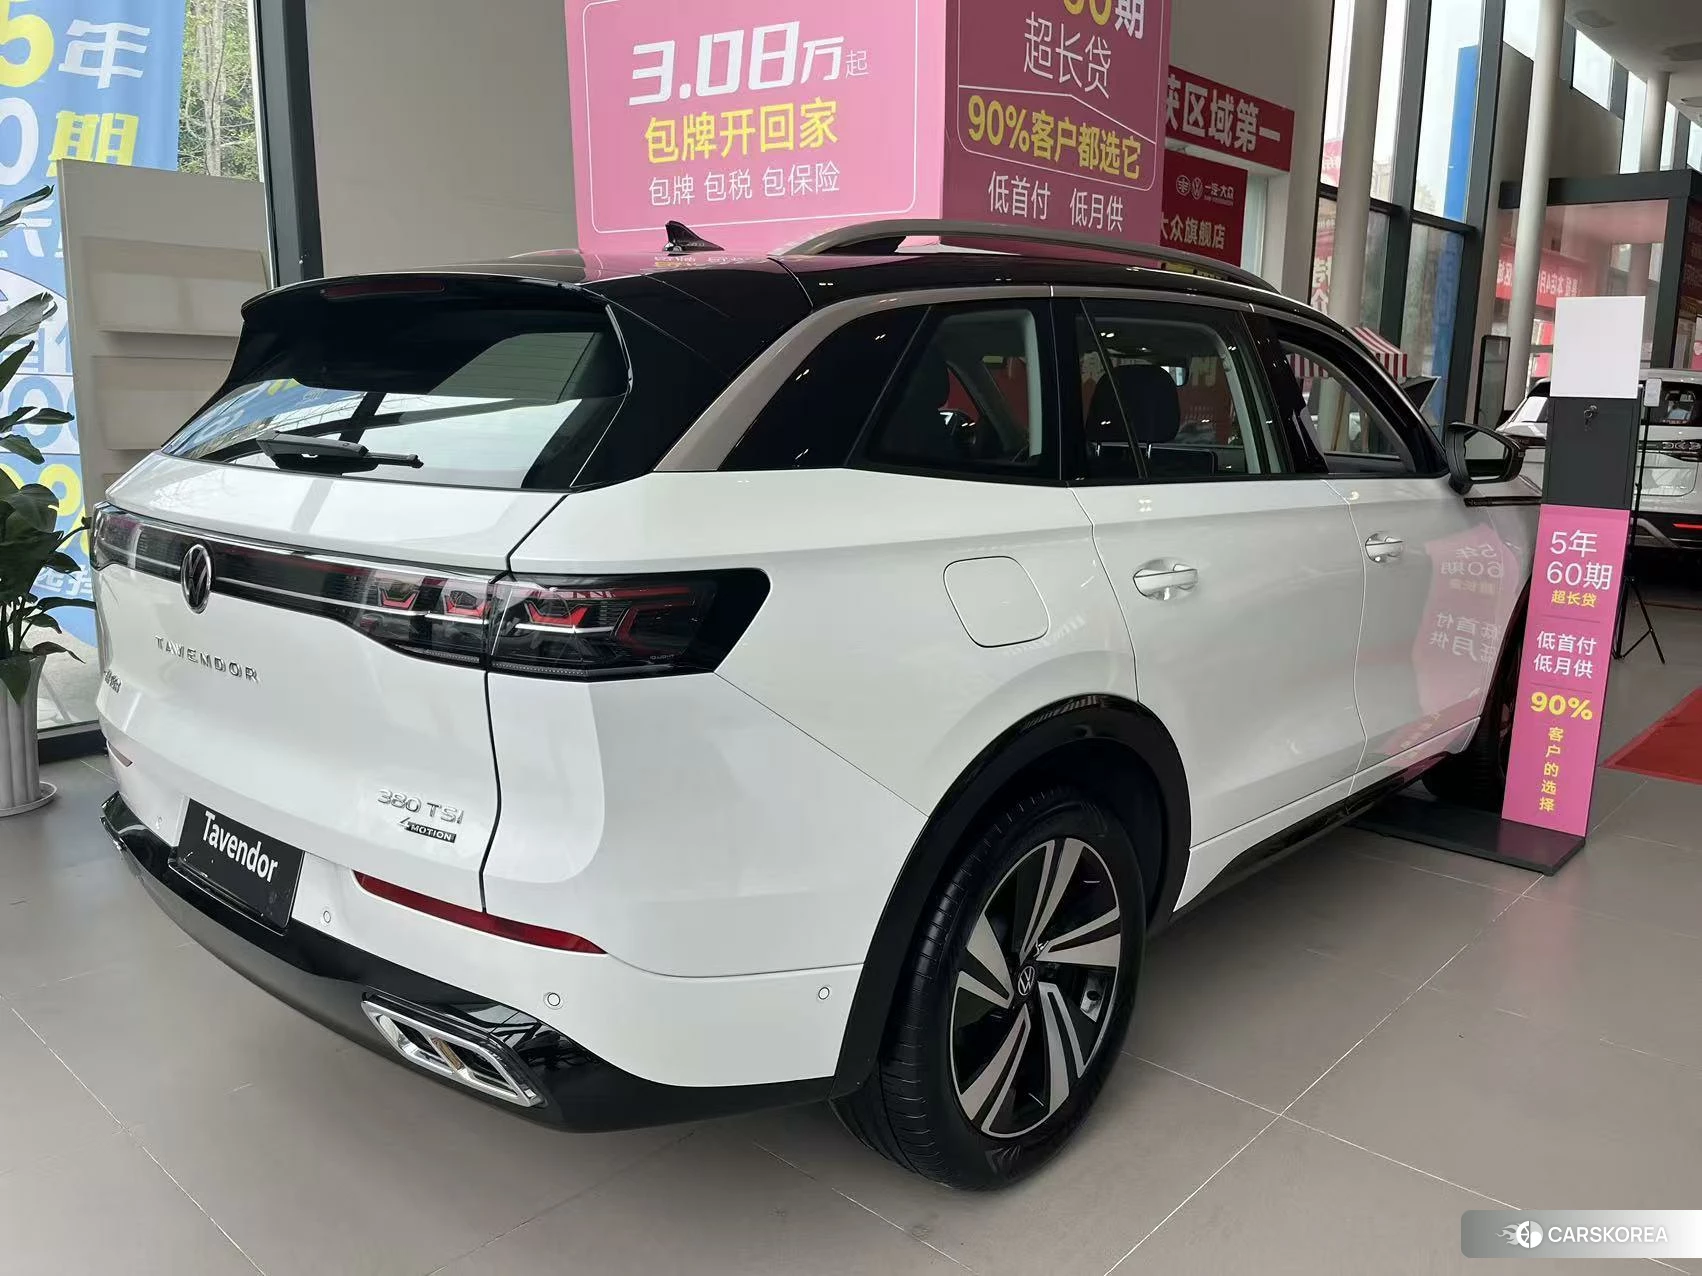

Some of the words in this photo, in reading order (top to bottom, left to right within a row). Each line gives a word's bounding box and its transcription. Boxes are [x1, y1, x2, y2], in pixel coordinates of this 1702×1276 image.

[1023, 11, 1112, 98] 超长贷
[645, 97, 838, 164] 包牌开回家
[968, 95, 1141, 180] 90%客户都选它
[648, 174, 695, 206] 包牌
[703, 170, 752, 202] 包税
[762, 160, 840, 198] 包保险
[988, 170, 1051, 221] 低首付
[1070, 188, 1124, 232] 低月供
[1549, 529, 1598, 558] 5年
[1546, 561, 1613, 591] 60期
[1551, 589, 1597, 608] 超长贷
[155, 635, 260, 684] TAVENDOR
[1536, 630, 1597, 656] 低首付
[1533, 653, 1593, 679] 低月供
[1530, 691, 1593, 721] 90%
[377, 788, 422, 814] 380
[427, 802, 465, 824] TSI
[201, 810, 279, 883] Tavendor
